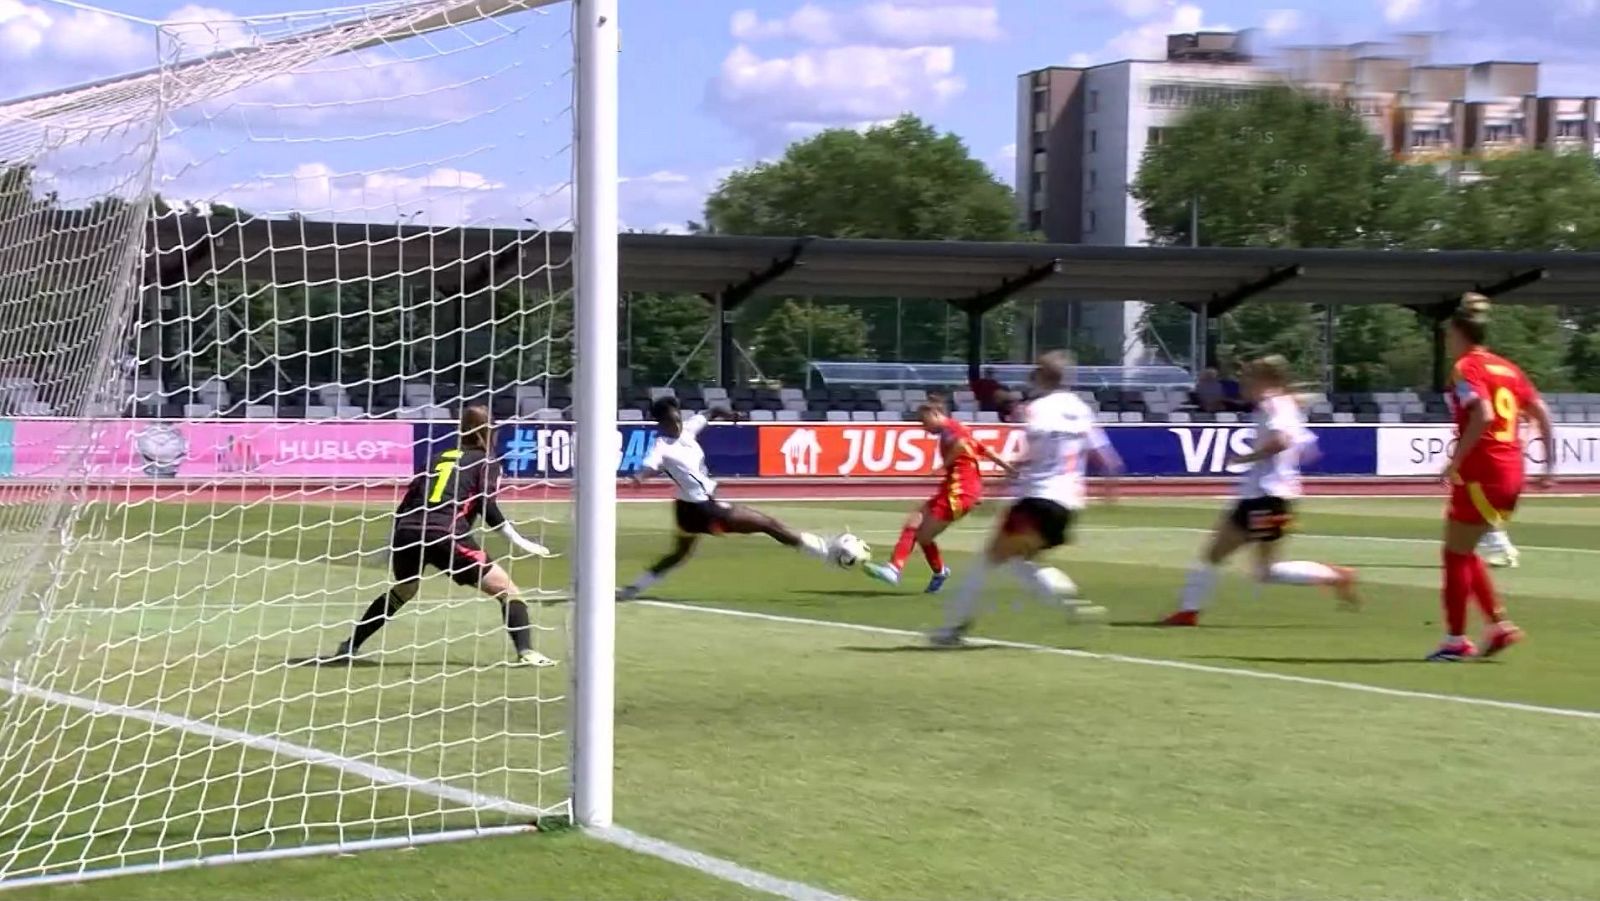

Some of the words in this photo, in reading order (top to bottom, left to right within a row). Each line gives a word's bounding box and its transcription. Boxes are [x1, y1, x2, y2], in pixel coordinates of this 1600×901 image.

[1495, 386, 1518, 442] 9
[280, 440, 391, 460] HUBLOT
[1169, 427, 1259, 473] VIS
[429, 461, 456, 503] 1
